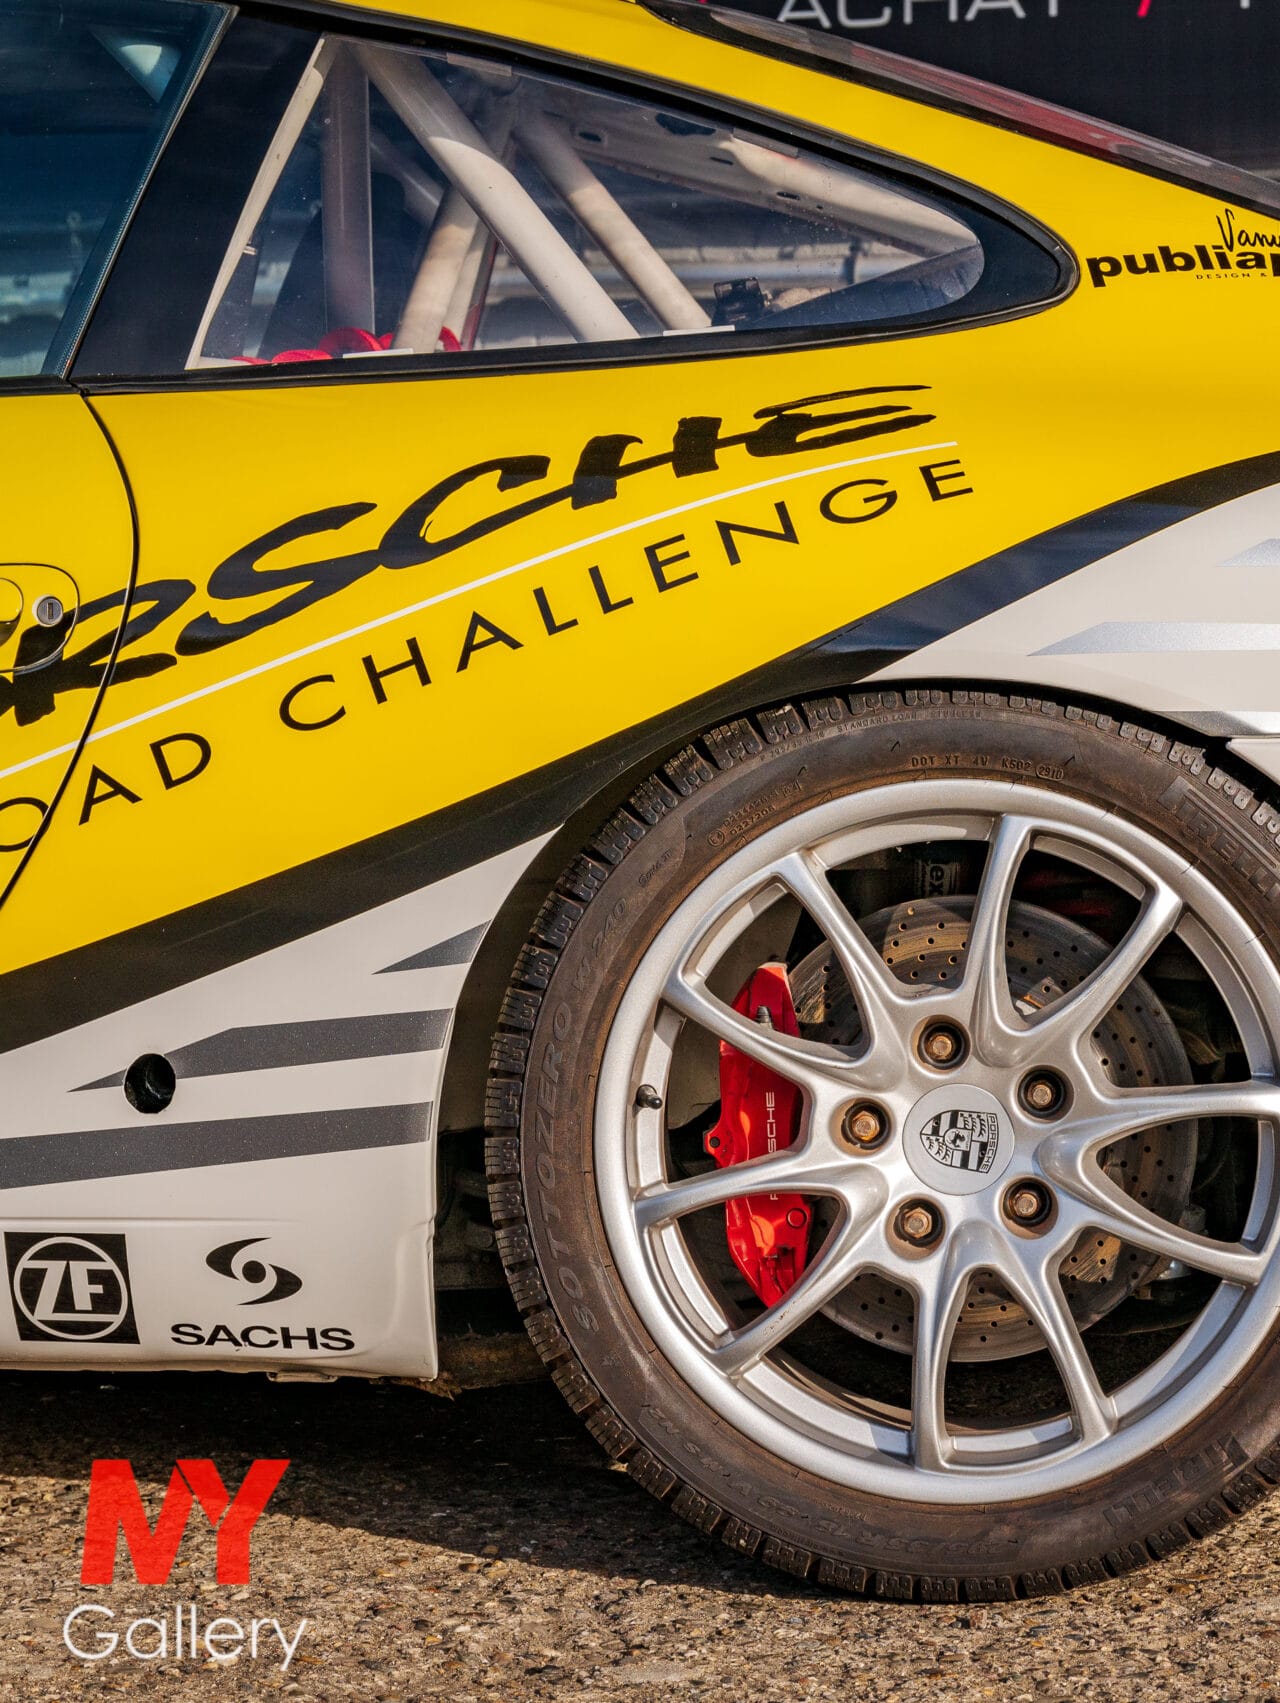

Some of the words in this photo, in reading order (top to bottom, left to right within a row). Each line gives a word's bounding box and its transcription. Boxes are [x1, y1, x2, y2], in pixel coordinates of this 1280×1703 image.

[1196, 271, 1251, 280] DESIGN
[279, 458, 974, 732] CHALLENGE
[909, 753, 935, 768] DOT
[944, 753, 960, 765] XT
[1000, 755, 1032, 772] K502
[1036, 763, 1065, 780] 2910
[534, 999, 598, 1334] SOTTOZERO
[980, 1115, 997, 1170] PORSCHE
[21, 1259, 116, 1322] ZF
[170, 1323, 355, 1351] SACHS
